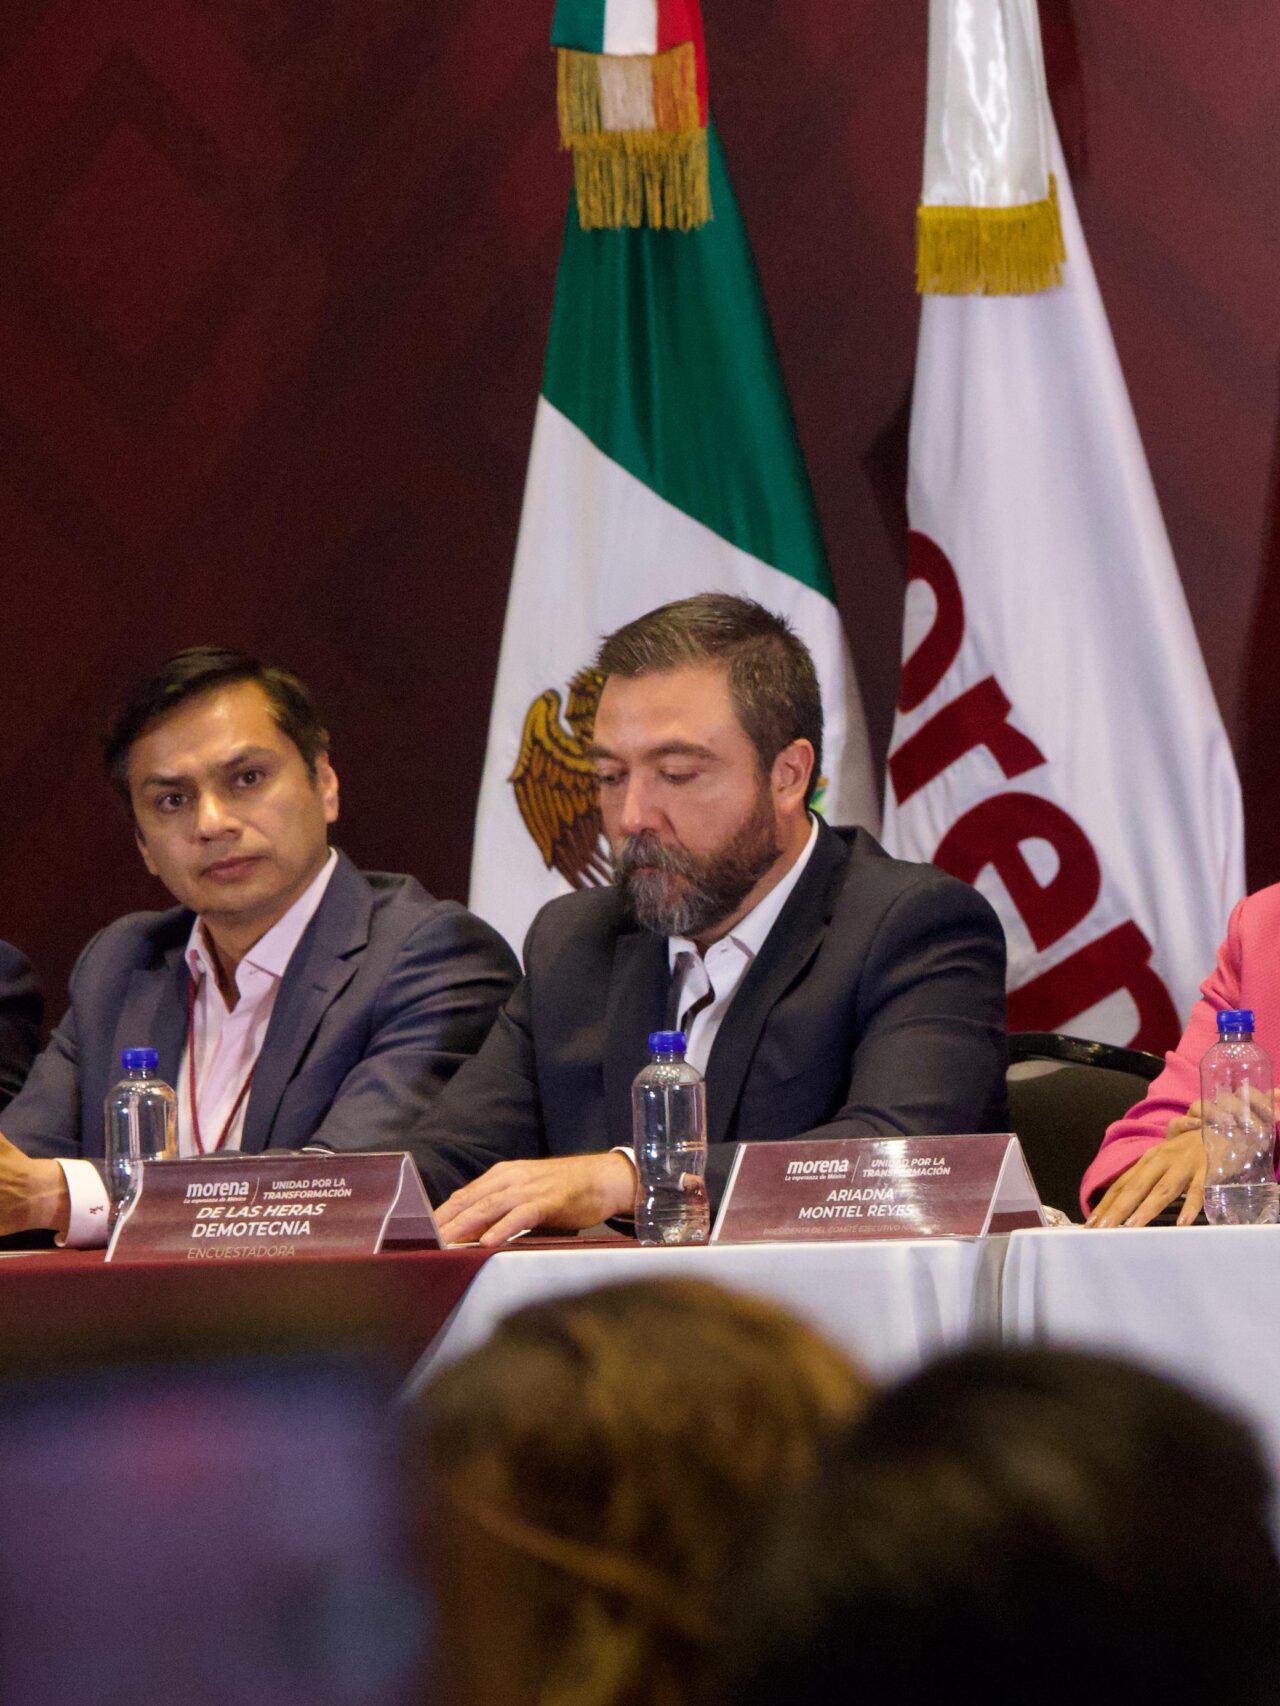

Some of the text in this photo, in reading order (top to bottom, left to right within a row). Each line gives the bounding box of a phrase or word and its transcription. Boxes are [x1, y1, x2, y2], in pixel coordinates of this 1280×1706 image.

[787, 1158, 849, 1174] morena
[910, 1158, 931, 1166] POR
[933, 1157, 945, 1166] LA
[186, 1181, 249, 1198] morena
[272, 1178, 346, 1190] UNIDAD POR LA
[263, 1188, 352, 1200] TRANSFORMACIÓN
[826, 1188, 895, 1202] ARIADNA
[196, 1203, 327, 1219] DE LAS HERAS
[798, 1204, 914, 1219] MONTIEL REYES
[191, 1221, 311, 1238] DEMOTECNIA
[187, 1244, 295, 1259] ENCUESTADORA
